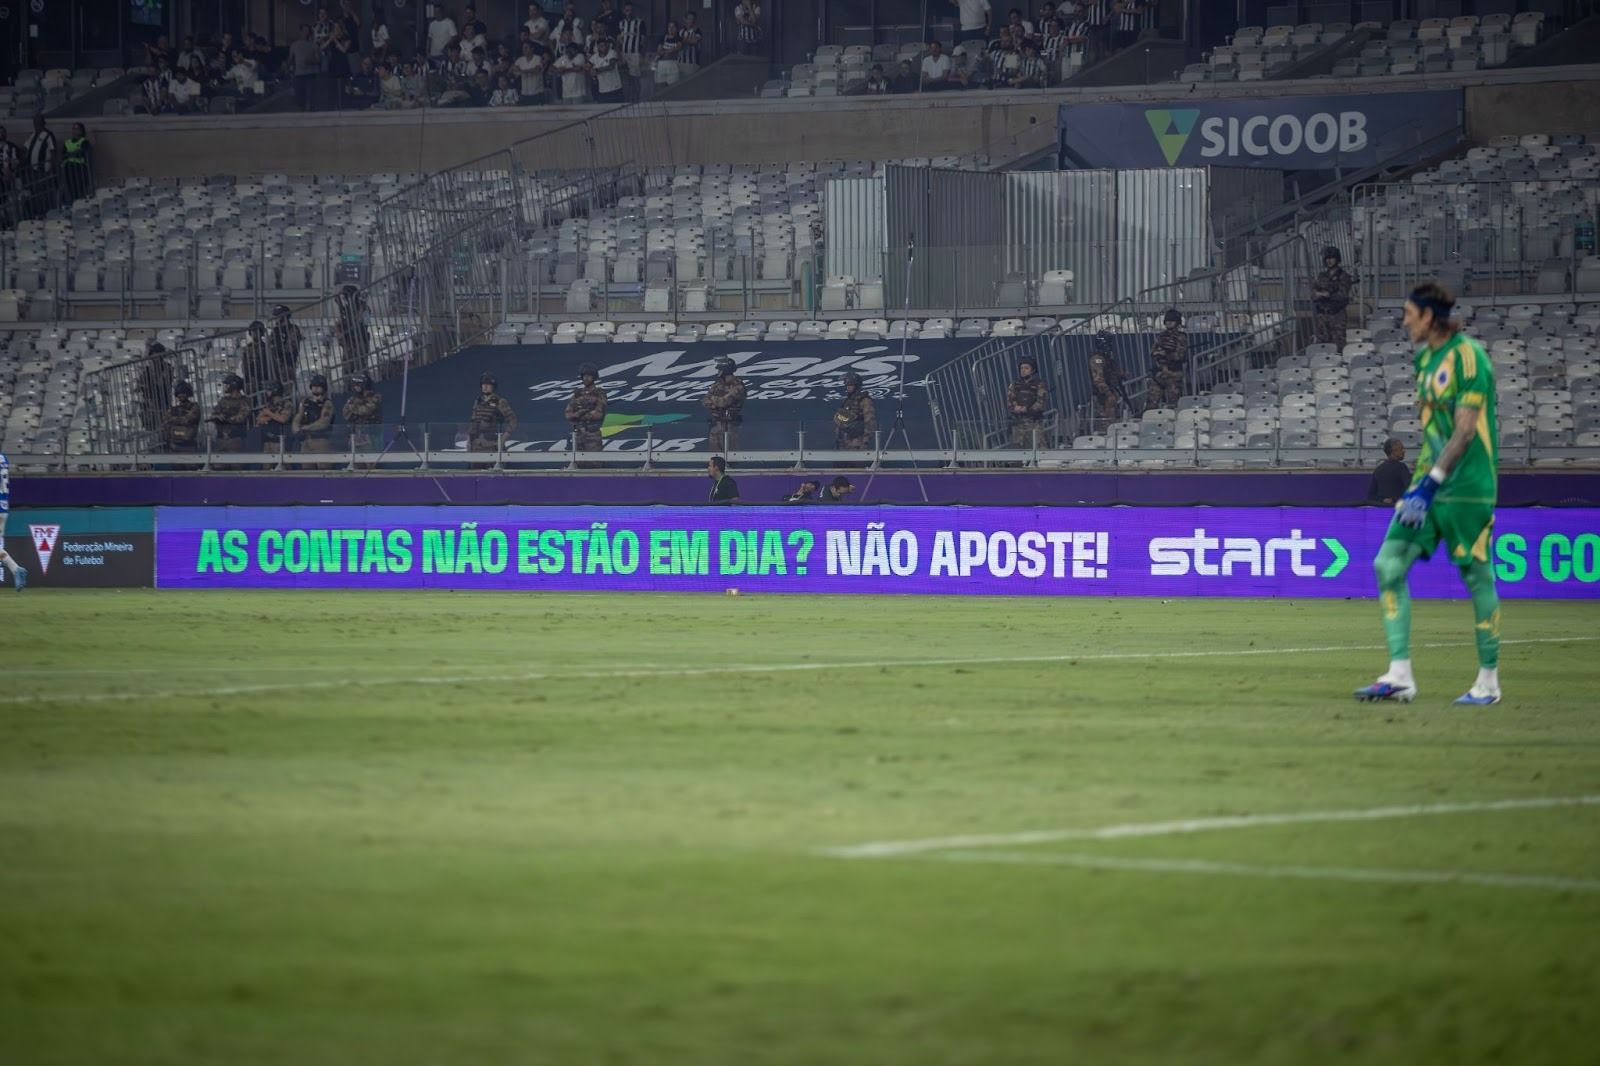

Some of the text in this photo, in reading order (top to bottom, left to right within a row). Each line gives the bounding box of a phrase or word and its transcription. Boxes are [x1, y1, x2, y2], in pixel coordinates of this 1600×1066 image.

[1200, 111, 1368, 157] SICOOB
[598, 346, 921, 377] Mais
[632, 379, 752, 391] um
[33, 527, 56, 538] FMF
[63, 541, 134, 553] Federação Mineira
[63, 555, 105, 565] de Futebol
[197, 521, 1109, 580] AS CONTAS NÃO ESTÃO EM DIA? NÃO APOSTE!
[1149, 528, 1318, 577] start
[1493, 533, 1528, 582] S
